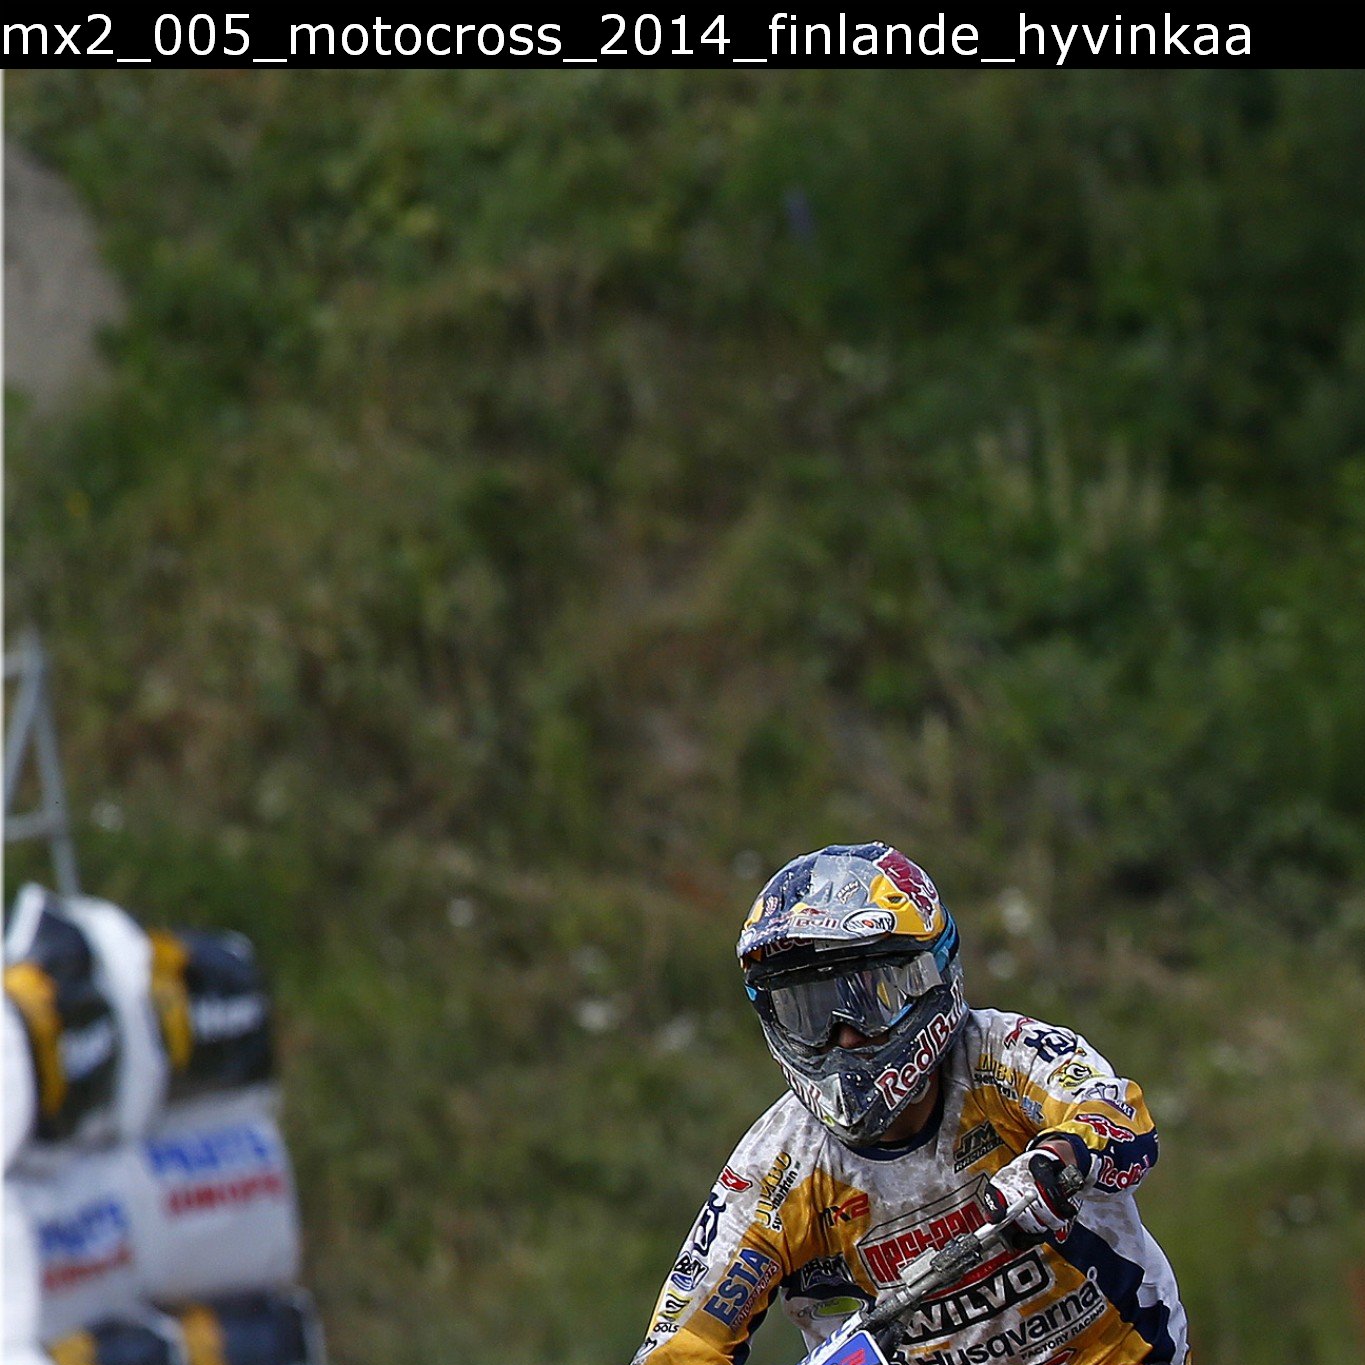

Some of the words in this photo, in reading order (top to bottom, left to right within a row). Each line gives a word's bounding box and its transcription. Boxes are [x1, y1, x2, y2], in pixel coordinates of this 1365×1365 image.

[875, 1029, 937, 1111] Red
[754, 1151, 792, 1227] JUMBO
[702, 1248, 770, 1326] ESTA
[905, 1259, 1042, 1339] WILVO
[1019, 1335, 1069, 1361] FACTORY
[1071, 1303, 1106, 1337] RACING
